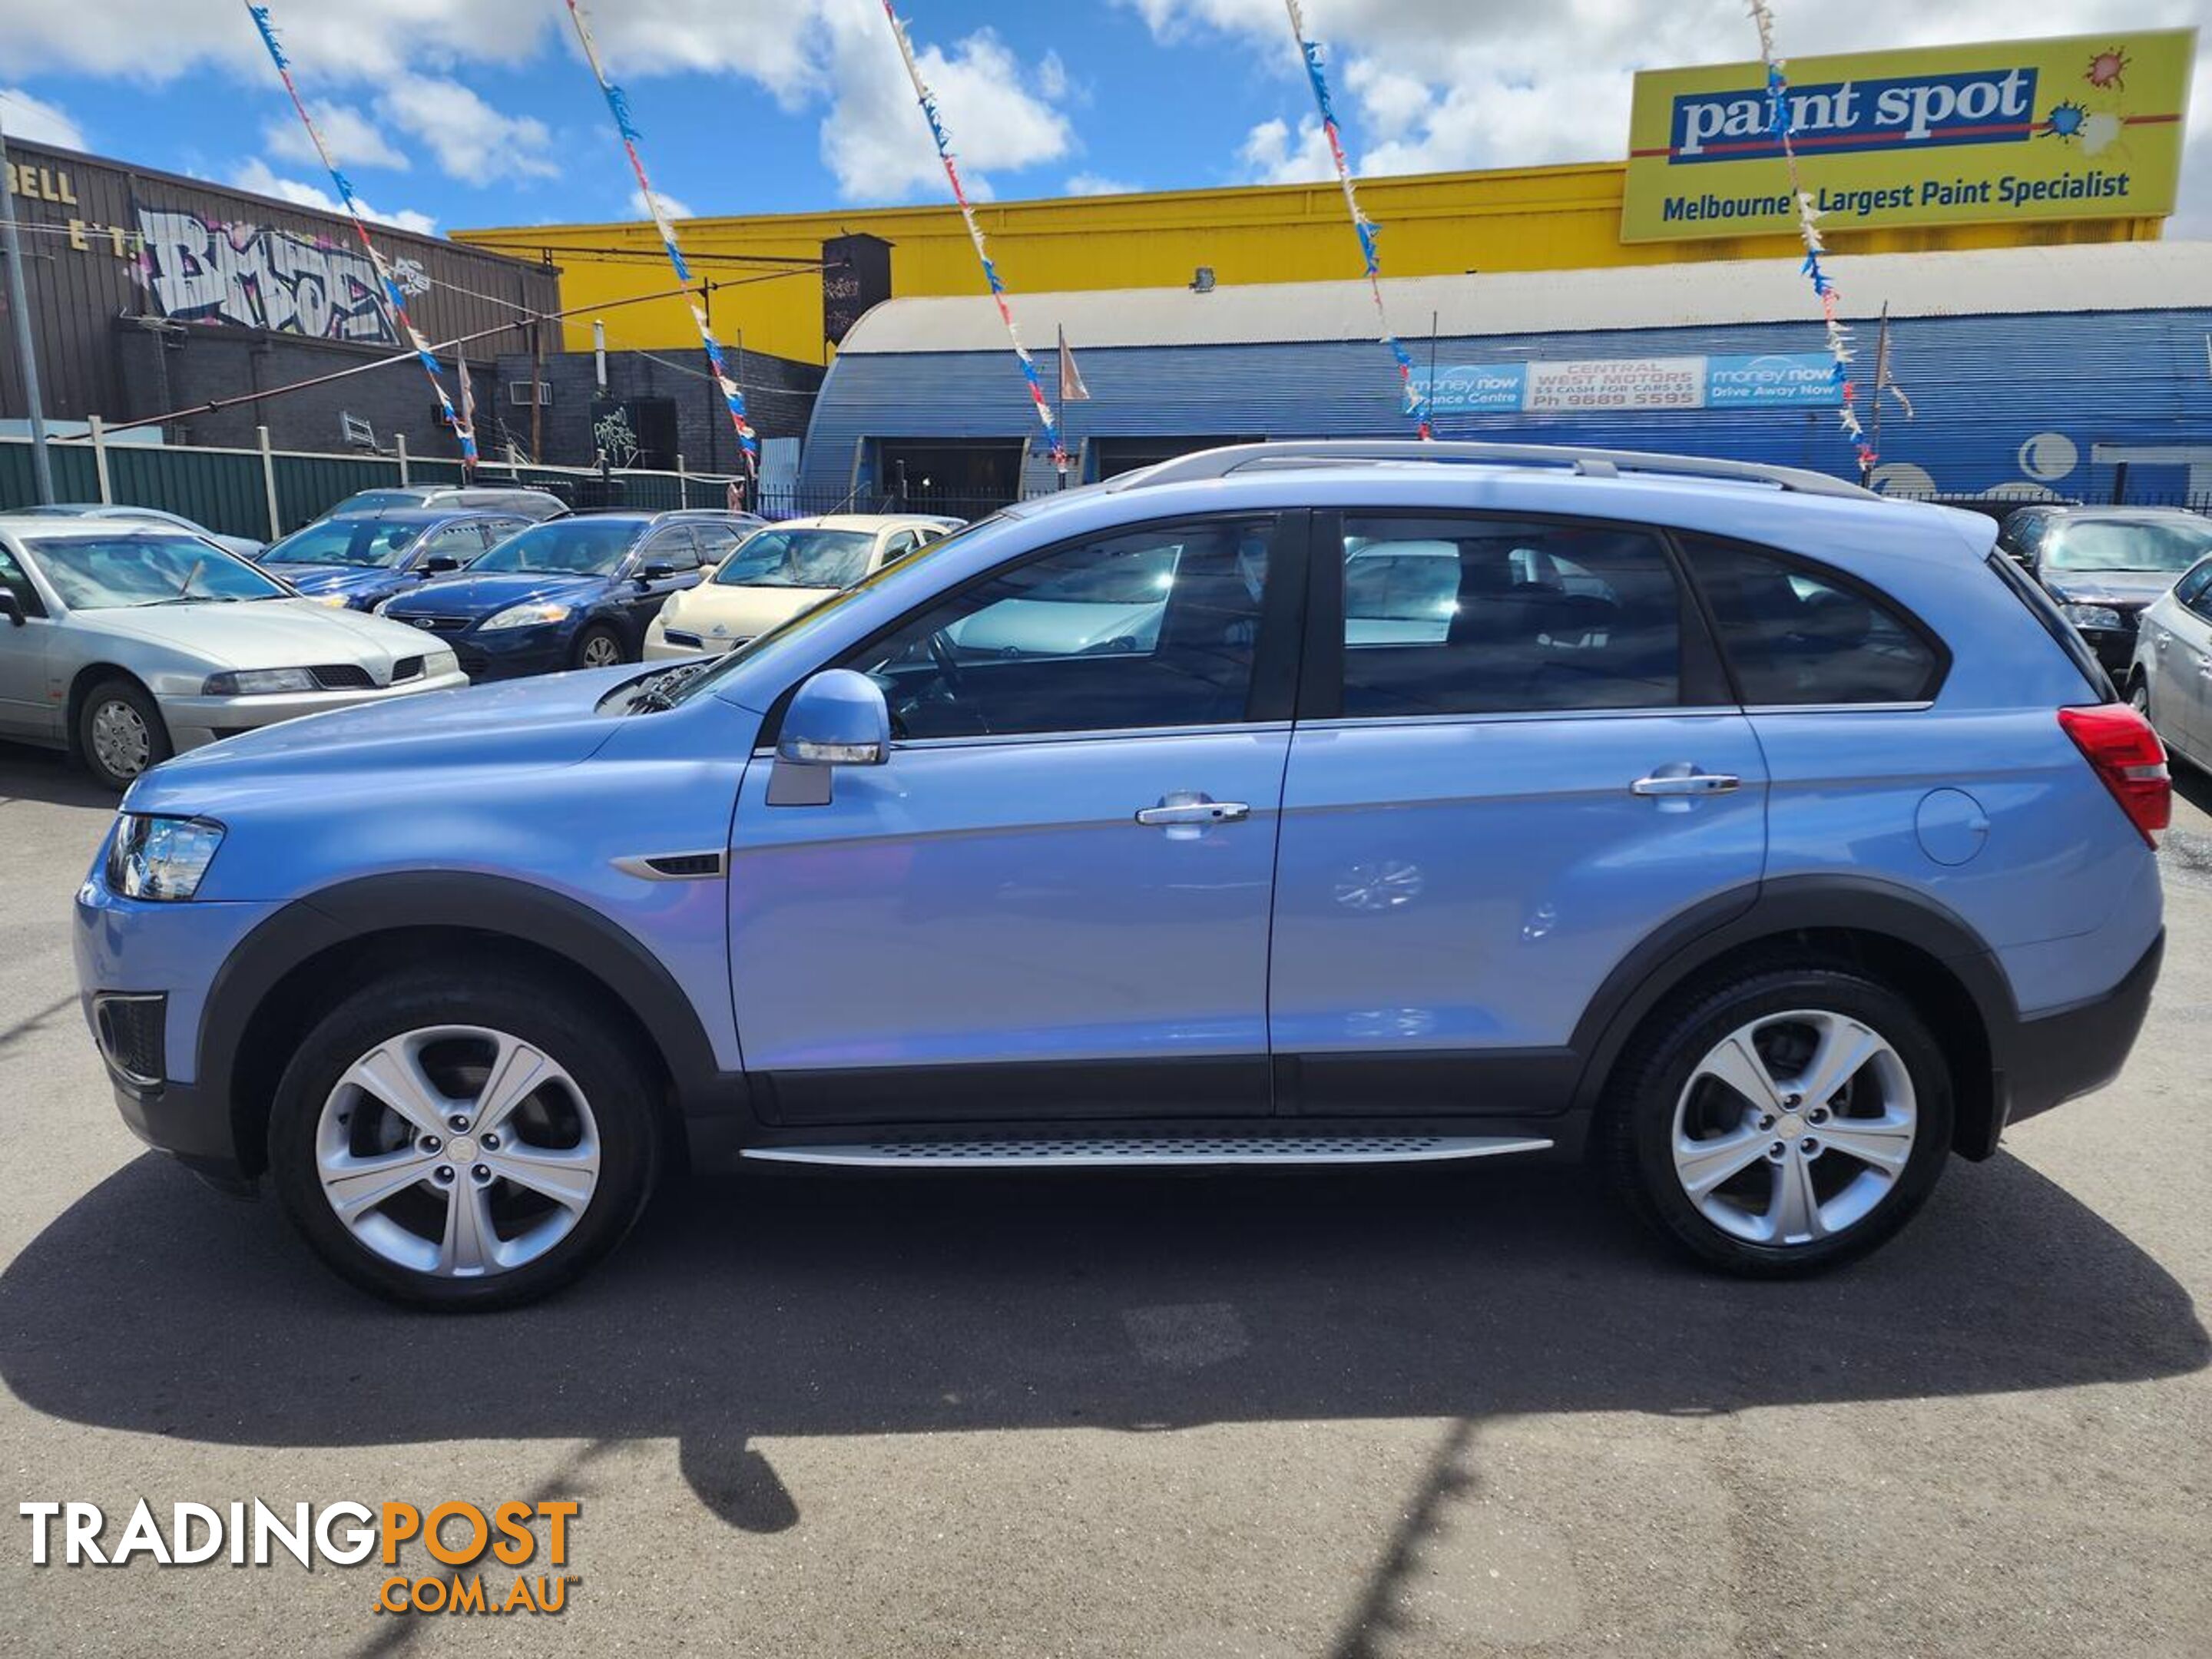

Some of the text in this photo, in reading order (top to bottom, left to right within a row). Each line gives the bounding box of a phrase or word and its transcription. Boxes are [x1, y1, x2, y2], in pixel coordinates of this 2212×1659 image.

[1875, 68, 2028, 139] spot
[1663, 171, 2130, 221] Melbourne' Largest Paint Specialist
[1568, 363, 1663, 374] CENTRAL
[1538, 373, 1693, 385] WEST MOTORS
[1713, 369, 1835, 383] money now
[1412, 377, 1518, 393] money now
[1557, 385, 1595, 393] CASH
[1600, 384, 1628, 392] FOR
[1712, 385, 1835, 398] Drive Away Now
[1417, 392, 1517, 405] ance Centre
[1534, 396, 1560, 406] Ph
